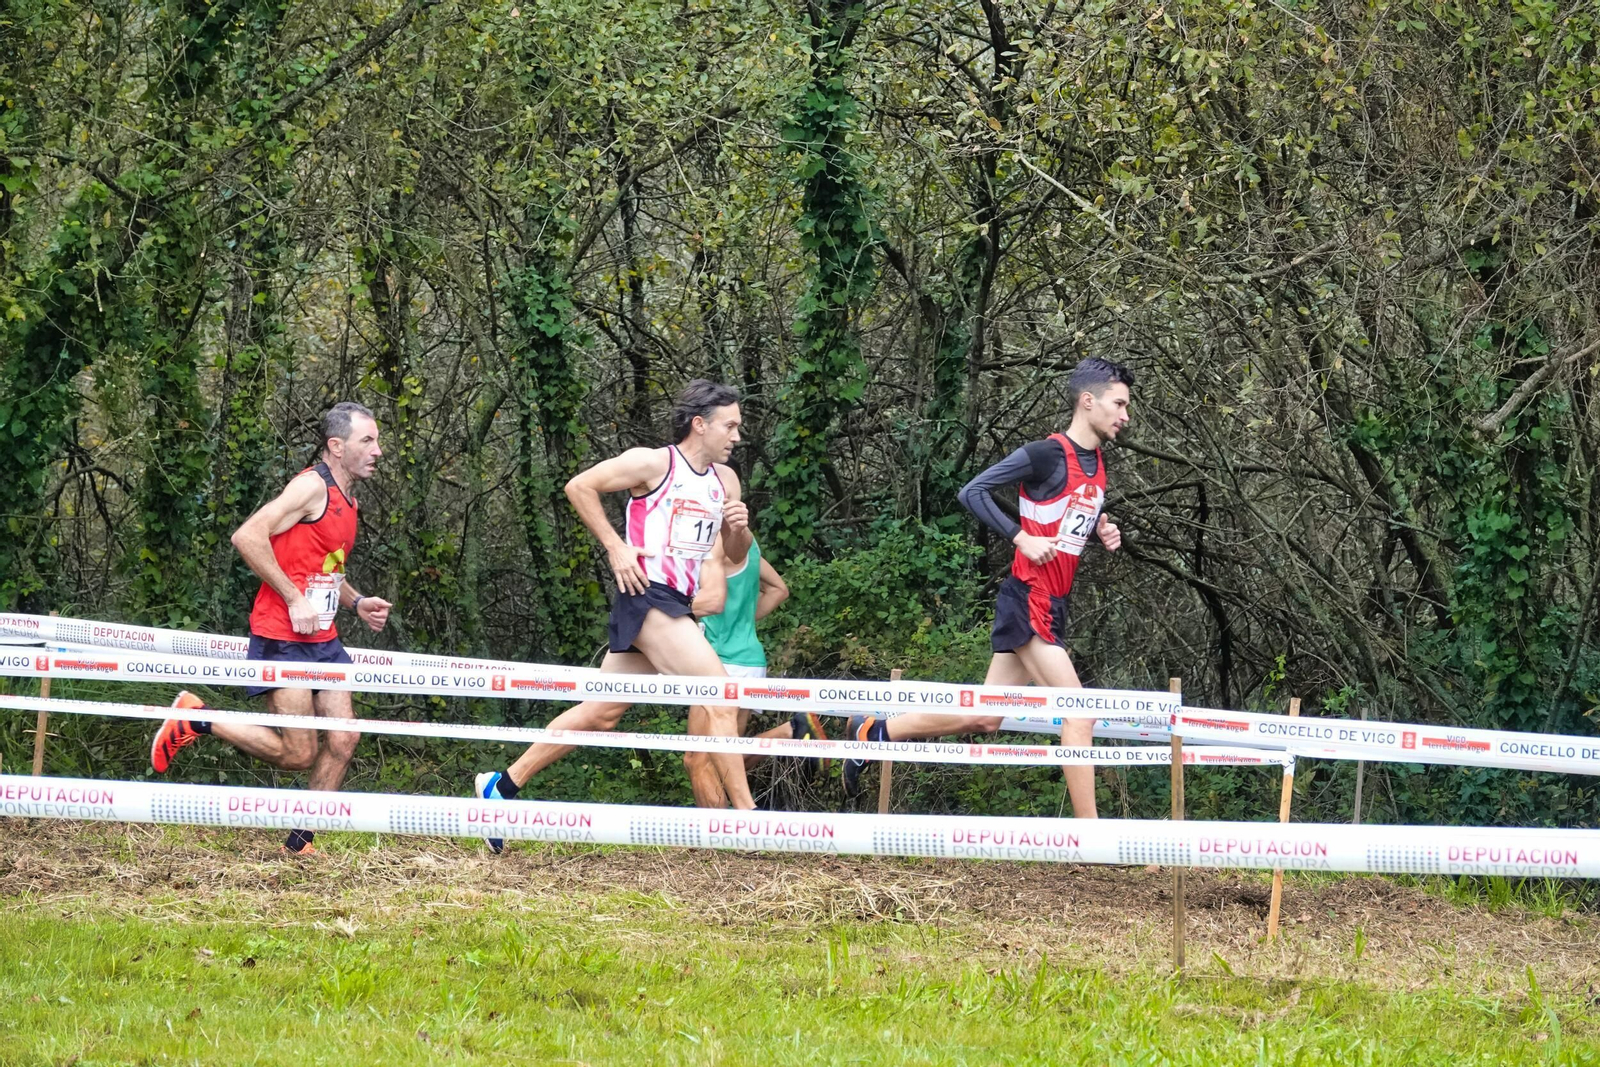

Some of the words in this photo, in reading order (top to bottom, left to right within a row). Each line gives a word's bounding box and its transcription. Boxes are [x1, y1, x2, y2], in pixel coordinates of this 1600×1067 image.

[694, 520, 714, 542] 11
[93, 637, 157, 652] PONTEVEDRA
[126, 662, 197, 675] CONCELLO
[203, 665, 220, 676] DE
[225, 667, 256, 678] VIGO
[354, 672, 426, 685] CONCELLO
[431, 675, 449, 686] DE
[453, 676, 486, 688] VIGO
[585, 681, 657, 694] CONCELLO
[663, 684, 681, 695] DE
[685, 685, 718, 696] VIGO
[819, 689, 892, 702] CONCELLO
[898, 692, 916, 703] DE
[920, 692, 954, 704] VIGO
[1056, 697, 1130, 710] CONCELLO
[1136, 701, 1154, 711] DE
[1259, 723, 1333, 739] CONCELLO
[1339, 729, 1358, 741] DE
[1362, 731, 1396, 744] VIGO
[844, 742, 909, 751] CONCELLO
[915, 744, 930, 753] DE
[934, 745, 964, 754] VIGO
[1055, 748, 1121, 760] CONCELLO
[1126, 752, 1142, 760] DE
[1500, 742, 1575, 758] CONCELLO
[1581, 748, 1600, 760] DE
[0, 784, 114, 805] EPUTACION
[0, 802, 118, 819] ONTEVEDRA
[228, 813, 355, 830] PONTEVEDRA
[467, 824, 597, 841] PONTEVEDRA
[709, 835, 838, 852] PONTEVEDRA
[953, 845, 1084, 861] PONTEVEDRA
[1200, 854, 1331, 869] PONTEVEDRA
[1448, 863, 1582, 877] PONTEVEDRA
